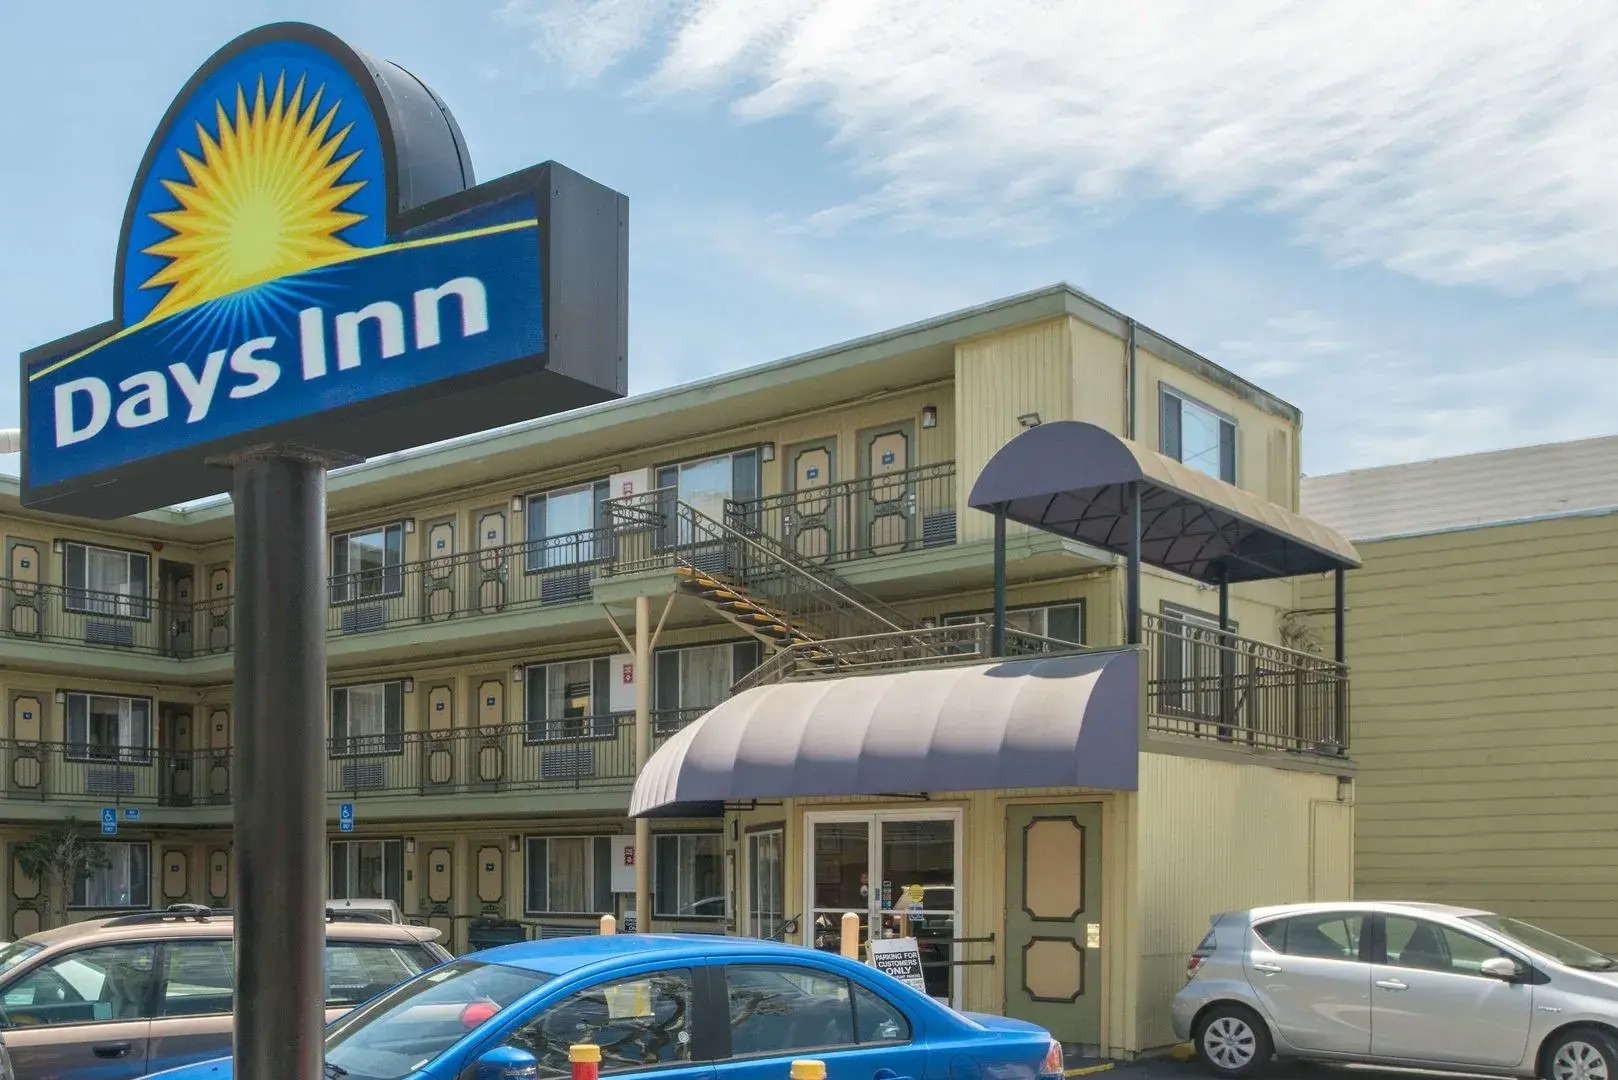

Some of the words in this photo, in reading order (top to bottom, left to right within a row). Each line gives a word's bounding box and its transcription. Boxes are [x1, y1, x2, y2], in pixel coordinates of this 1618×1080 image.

[54, 335, 282, 448] Days
[299, 275, 489, 381] Inn
[878, 959, 917, 967] CUSTOMERS
[886, 966, 911, 975] ONLY
